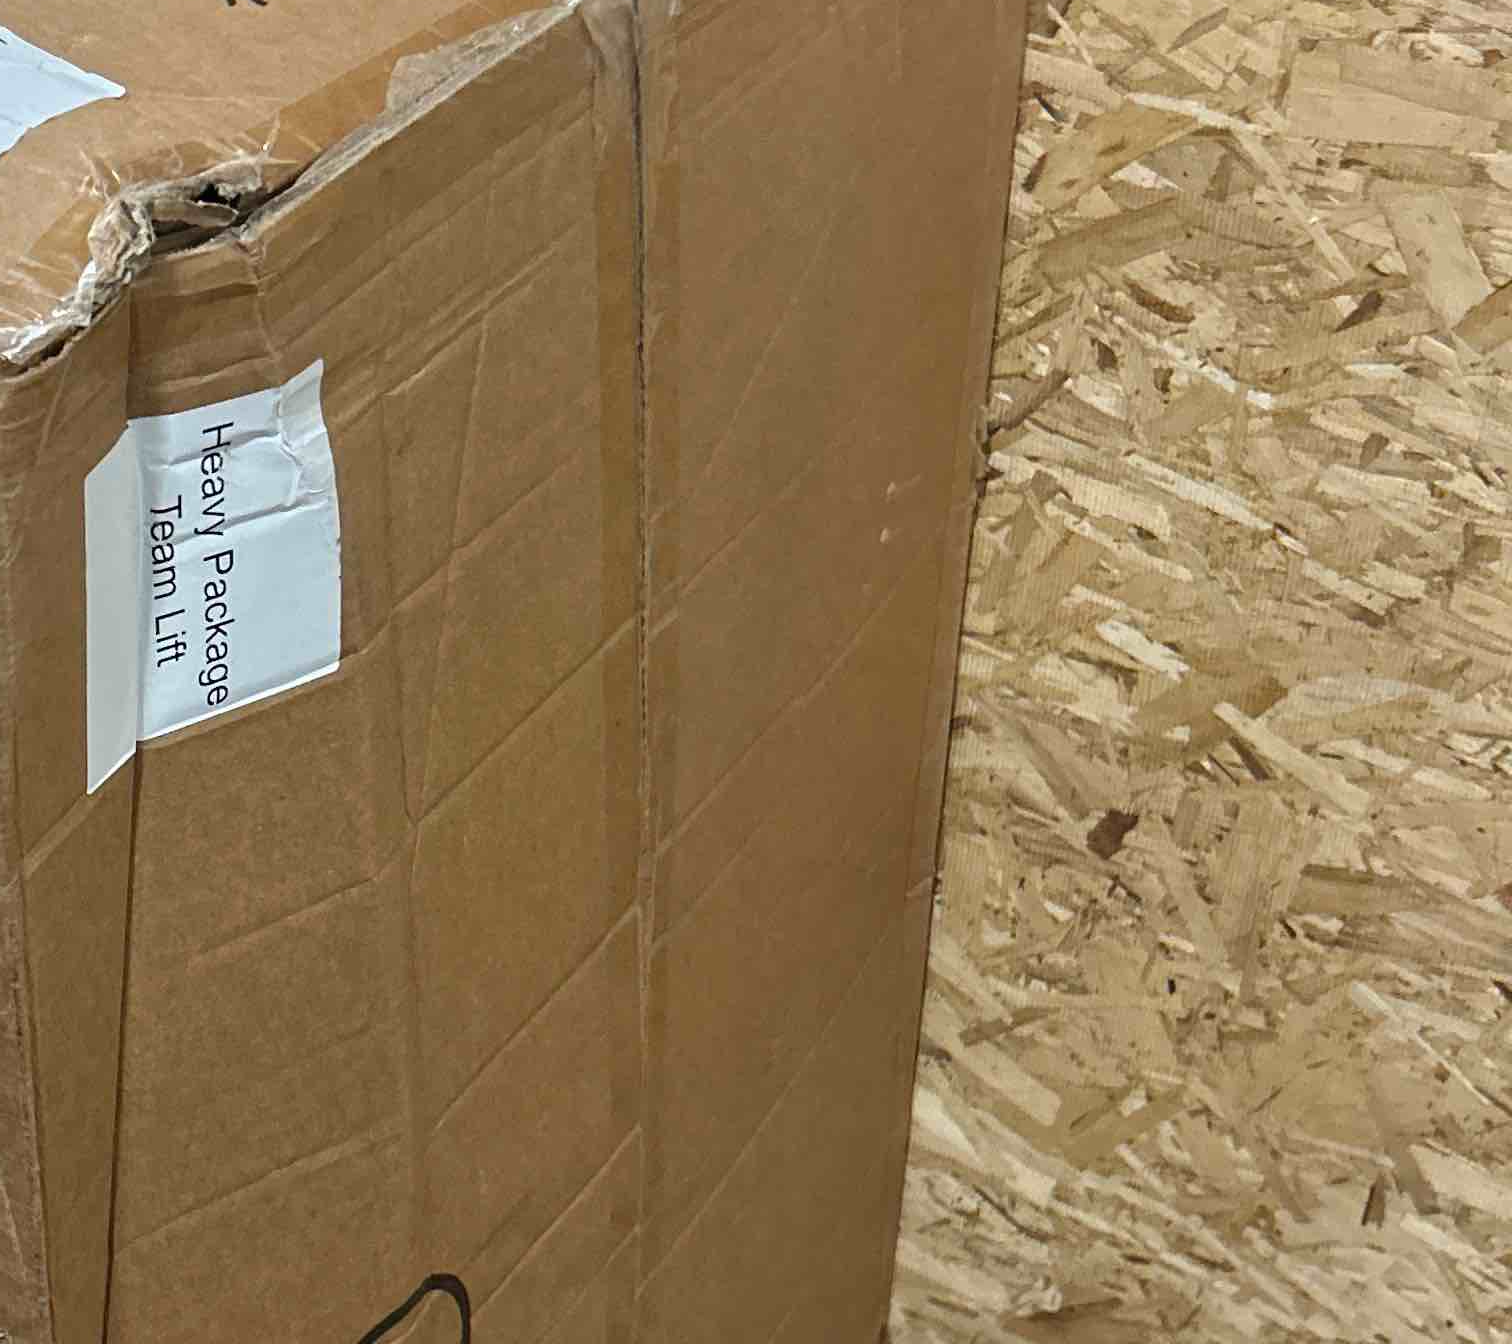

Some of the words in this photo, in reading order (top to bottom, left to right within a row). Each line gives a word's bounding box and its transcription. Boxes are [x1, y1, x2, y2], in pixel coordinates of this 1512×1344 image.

[194, 420, 235, 538] Heavy
[149, 494, 182, 601] Team
[154, 606, 188, 668] Lift
[197, 548, 236, 707] Package
